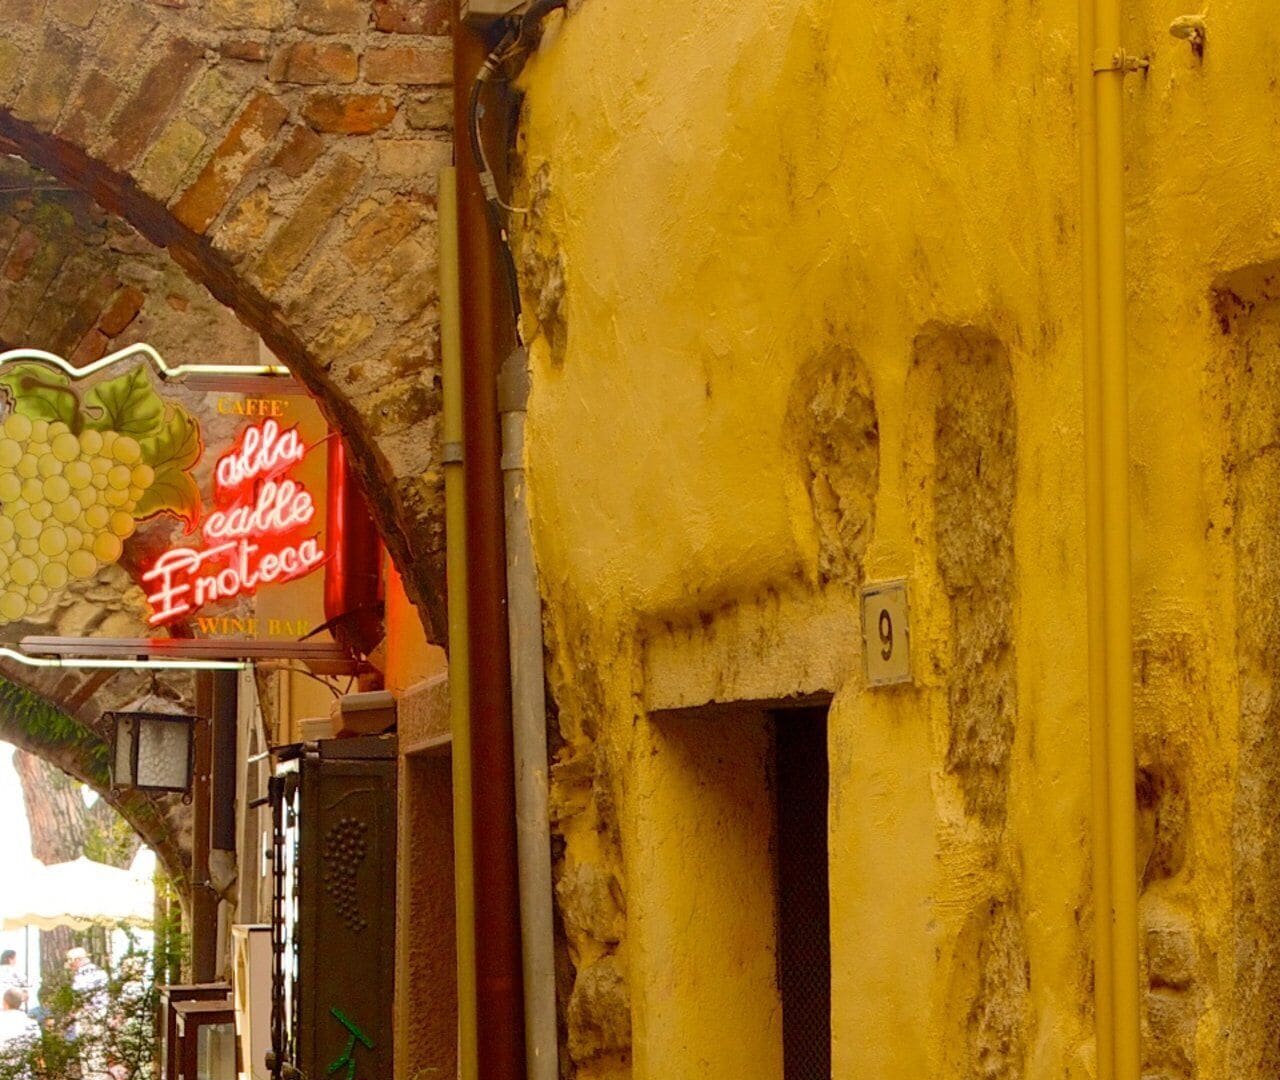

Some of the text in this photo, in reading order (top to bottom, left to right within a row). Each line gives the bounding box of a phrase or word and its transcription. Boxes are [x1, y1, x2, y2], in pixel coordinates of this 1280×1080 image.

[217, 419, 304, 486] alla
[204, 480, 315, 538] calle
[142, 538, 325, 624] Enoteca
[198, 617, 309, 637] WINE BAR
[878, 608, 894, 662] 9
